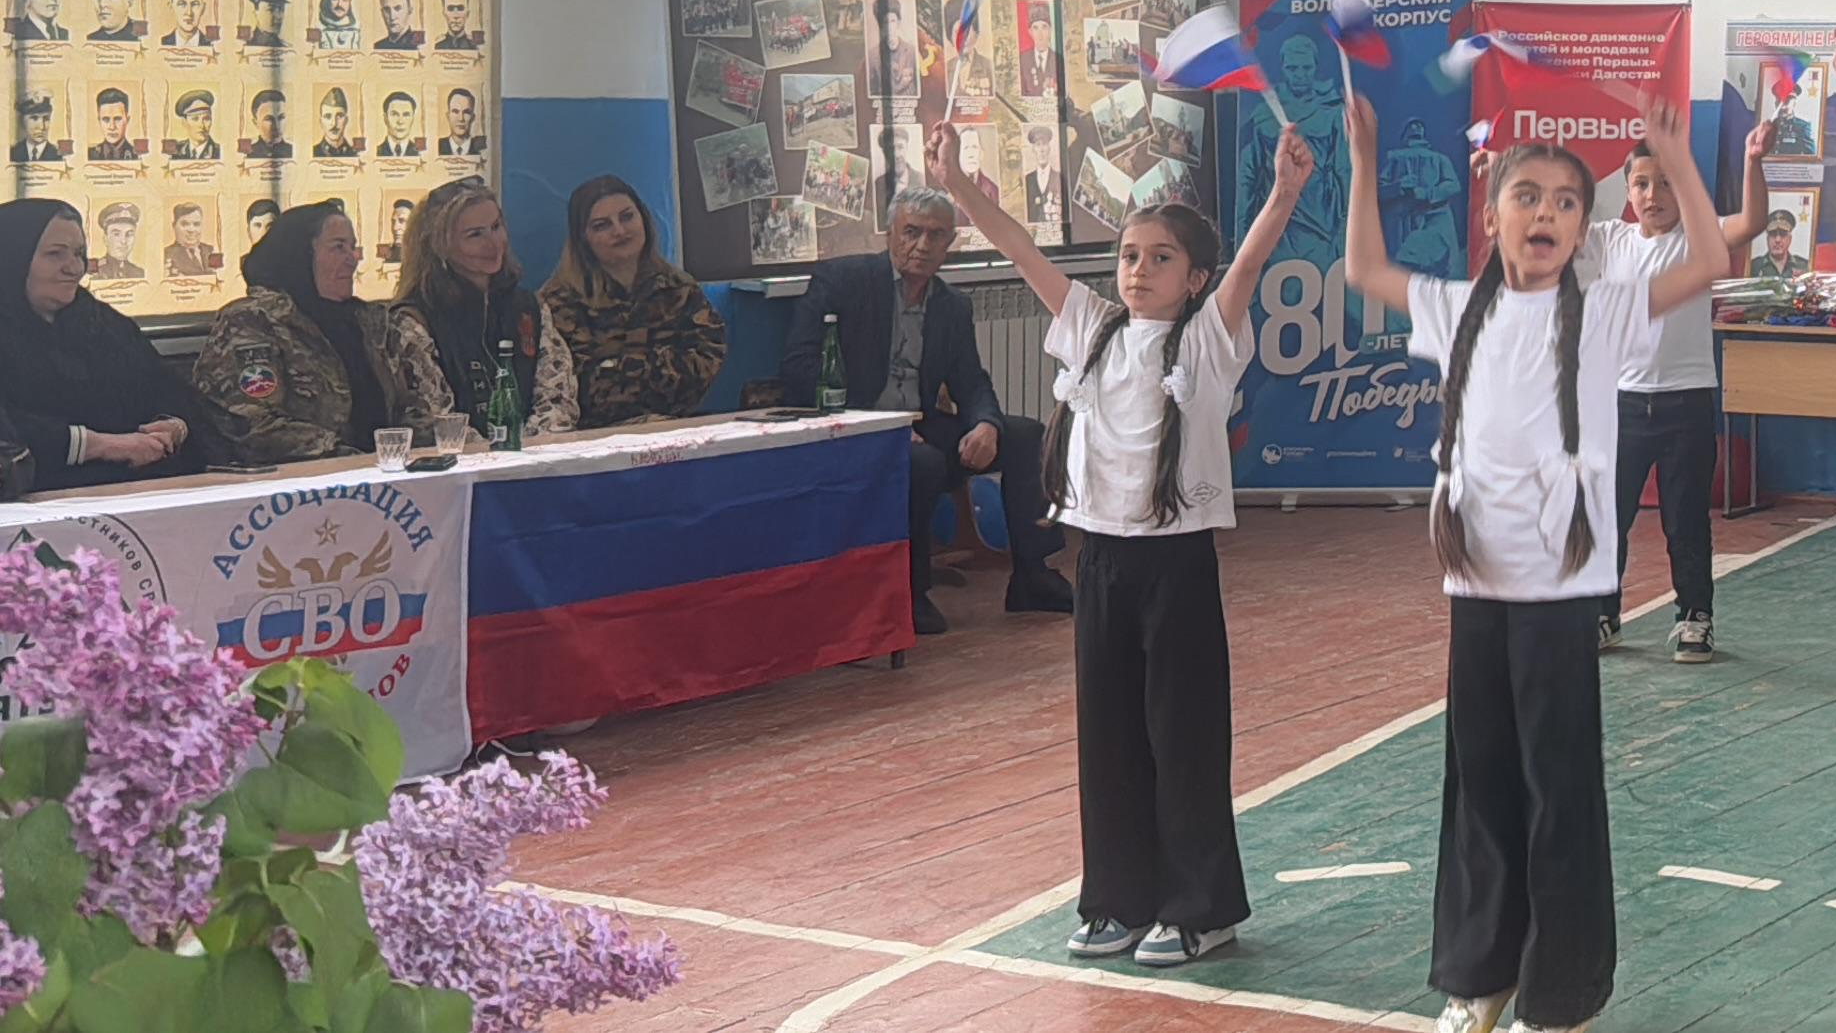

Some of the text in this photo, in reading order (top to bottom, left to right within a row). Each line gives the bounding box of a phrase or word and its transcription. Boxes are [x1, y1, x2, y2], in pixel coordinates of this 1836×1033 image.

[1374, 9, 1452, 28] КОРПУС
[1498, 30, 1666, 44] Российское движение
[1737, 30, 1801, 46] ГЕРОЯМИ
[1804, 31, 1825, 46] НЕ
[1560, 46, 1570, 55] и
[1592, 70, 1661, 80] Дагестан
[1513, 109, 1647, 145] Первые
[213, 482, 434, 581] АССОЦИАЦИЯ
[242, 578, 401, 661] СВО
